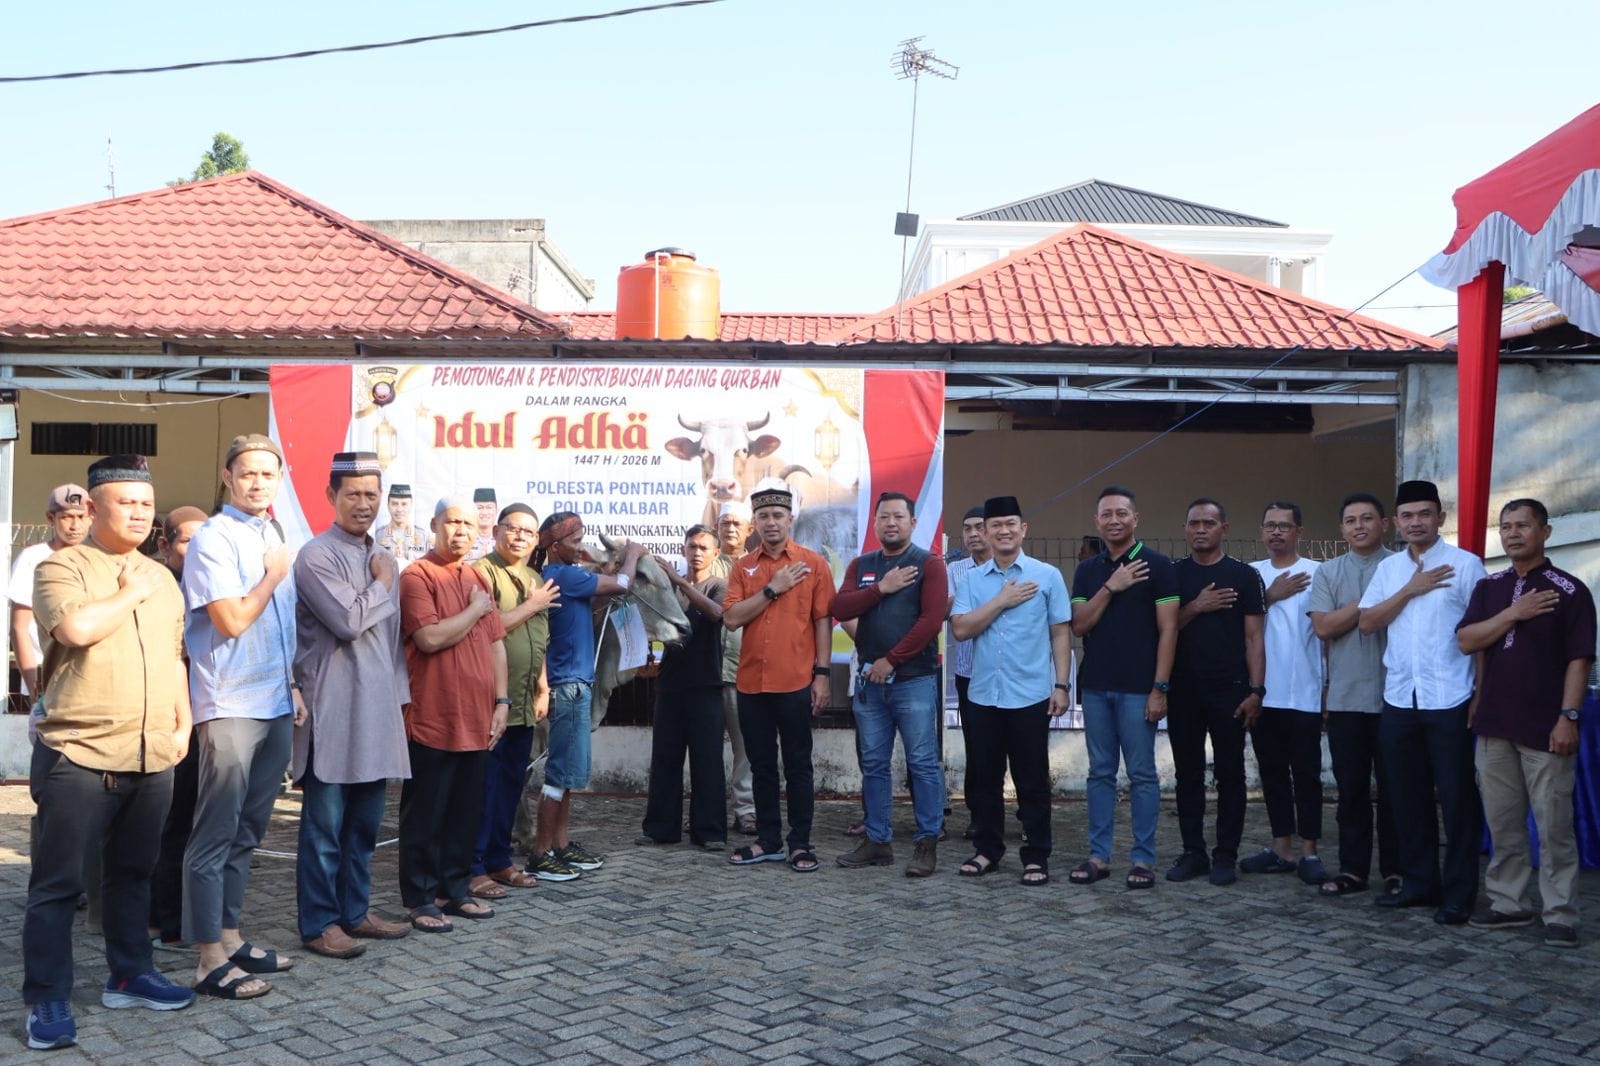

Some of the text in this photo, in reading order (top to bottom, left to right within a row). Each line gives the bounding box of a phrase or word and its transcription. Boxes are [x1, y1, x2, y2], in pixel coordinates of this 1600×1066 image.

[432, 366, 782, 391] PEMOTONGAN & PENDISTRIBUSIAN DAGING QURBAN
[525, 395, 627, 407] DALAM RANGKA
[433, 411, 518, 448] Idul
[574, 455, 599, 465] 1447
[603, 455, 612, 465] H
[622, 455, 648, 466] 2026
[651, 455, 661, 466] M
[527, 481, 696, 496] POLRESTA PONTIANAK
[553, 501, 669, 515] POLDA KALBAR
